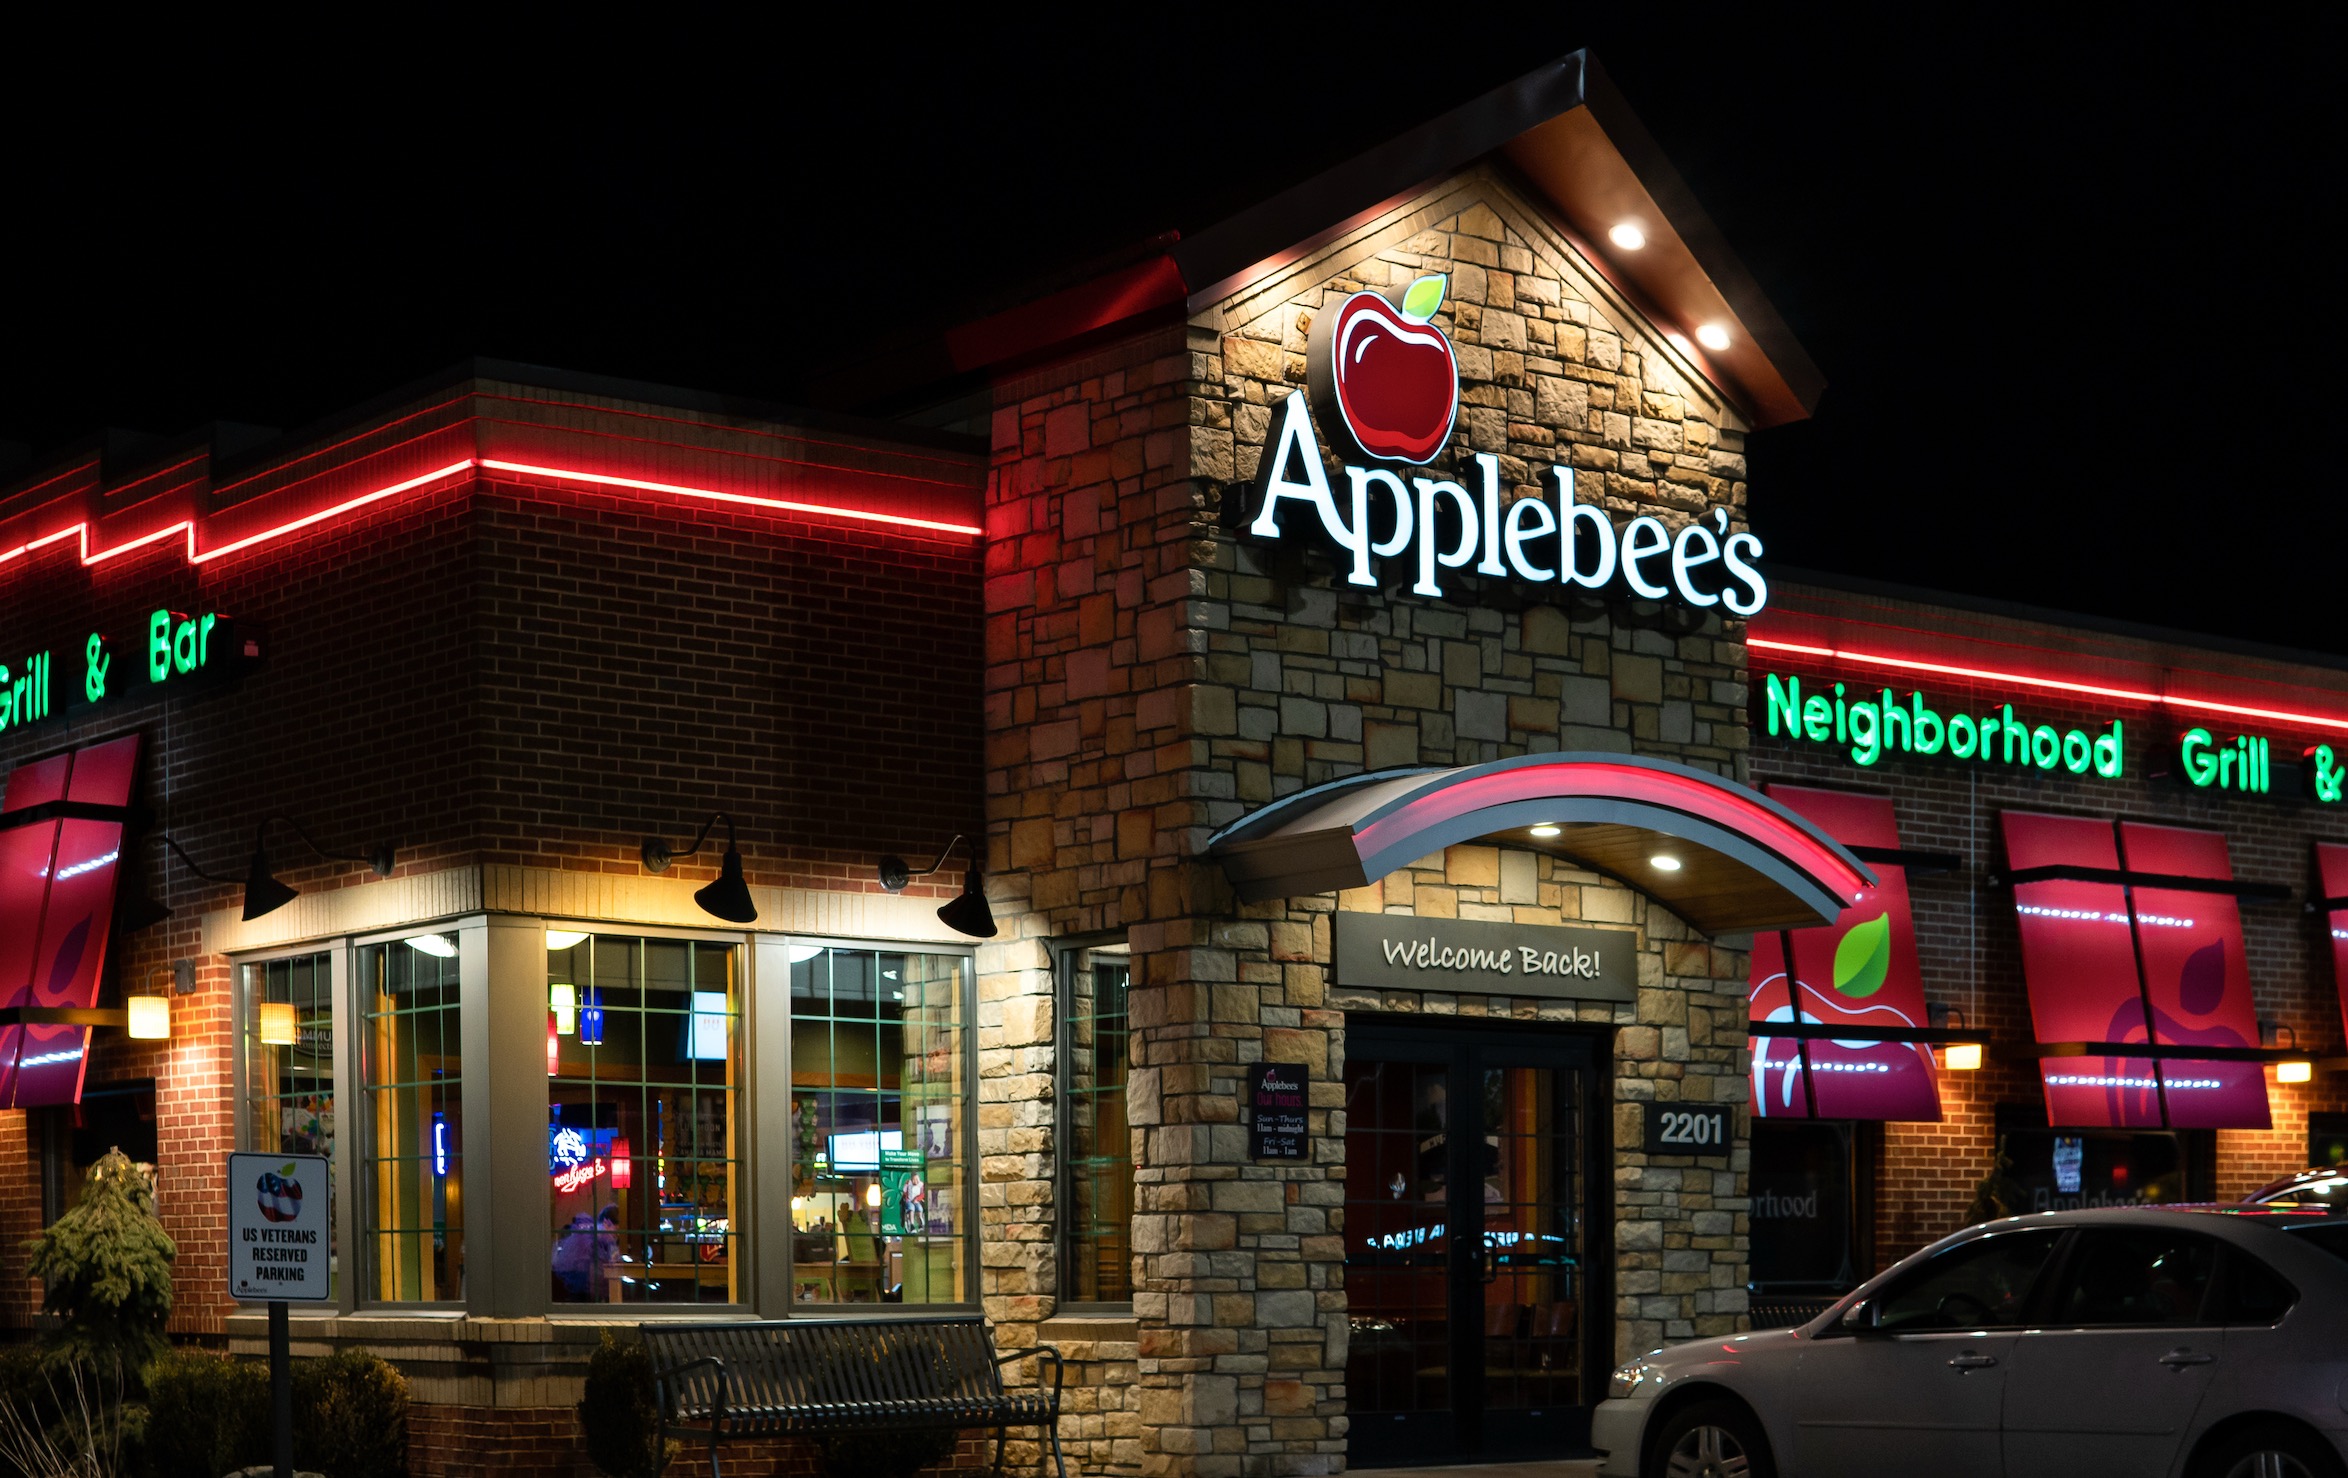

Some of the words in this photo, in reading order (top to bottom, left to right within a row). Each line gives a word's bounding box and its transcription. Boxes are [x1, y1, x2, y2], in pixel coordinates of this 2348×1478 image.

[1250, 389, 1768, 616] Applebee's
[86, 632, 110, 703] &
[150, 609, 215, 683] Bar
[1766, 673, 2123, 778] Neighborhood
[2181, 727, 2270, 793] Grill
[2314, 744, 2346, 802] &
[1382, 936, 1513, 974] Welcome
[1517, 944, 1601, 979] Back!
[1257, 1092, 1273, 1106] Our
[1257, 1123, 1273, 1133] 11am
[1278, 1123, 1304, 1134] midnight
[1660, 1112, 1723, 1145] 2201
[242, 1227, 258, 1242] US
[261, 1228, 317, 1244] VETERANS
[252, 1247, 308, 1262] RESERVED
[256, 1266, 305, 1281] PARKING
